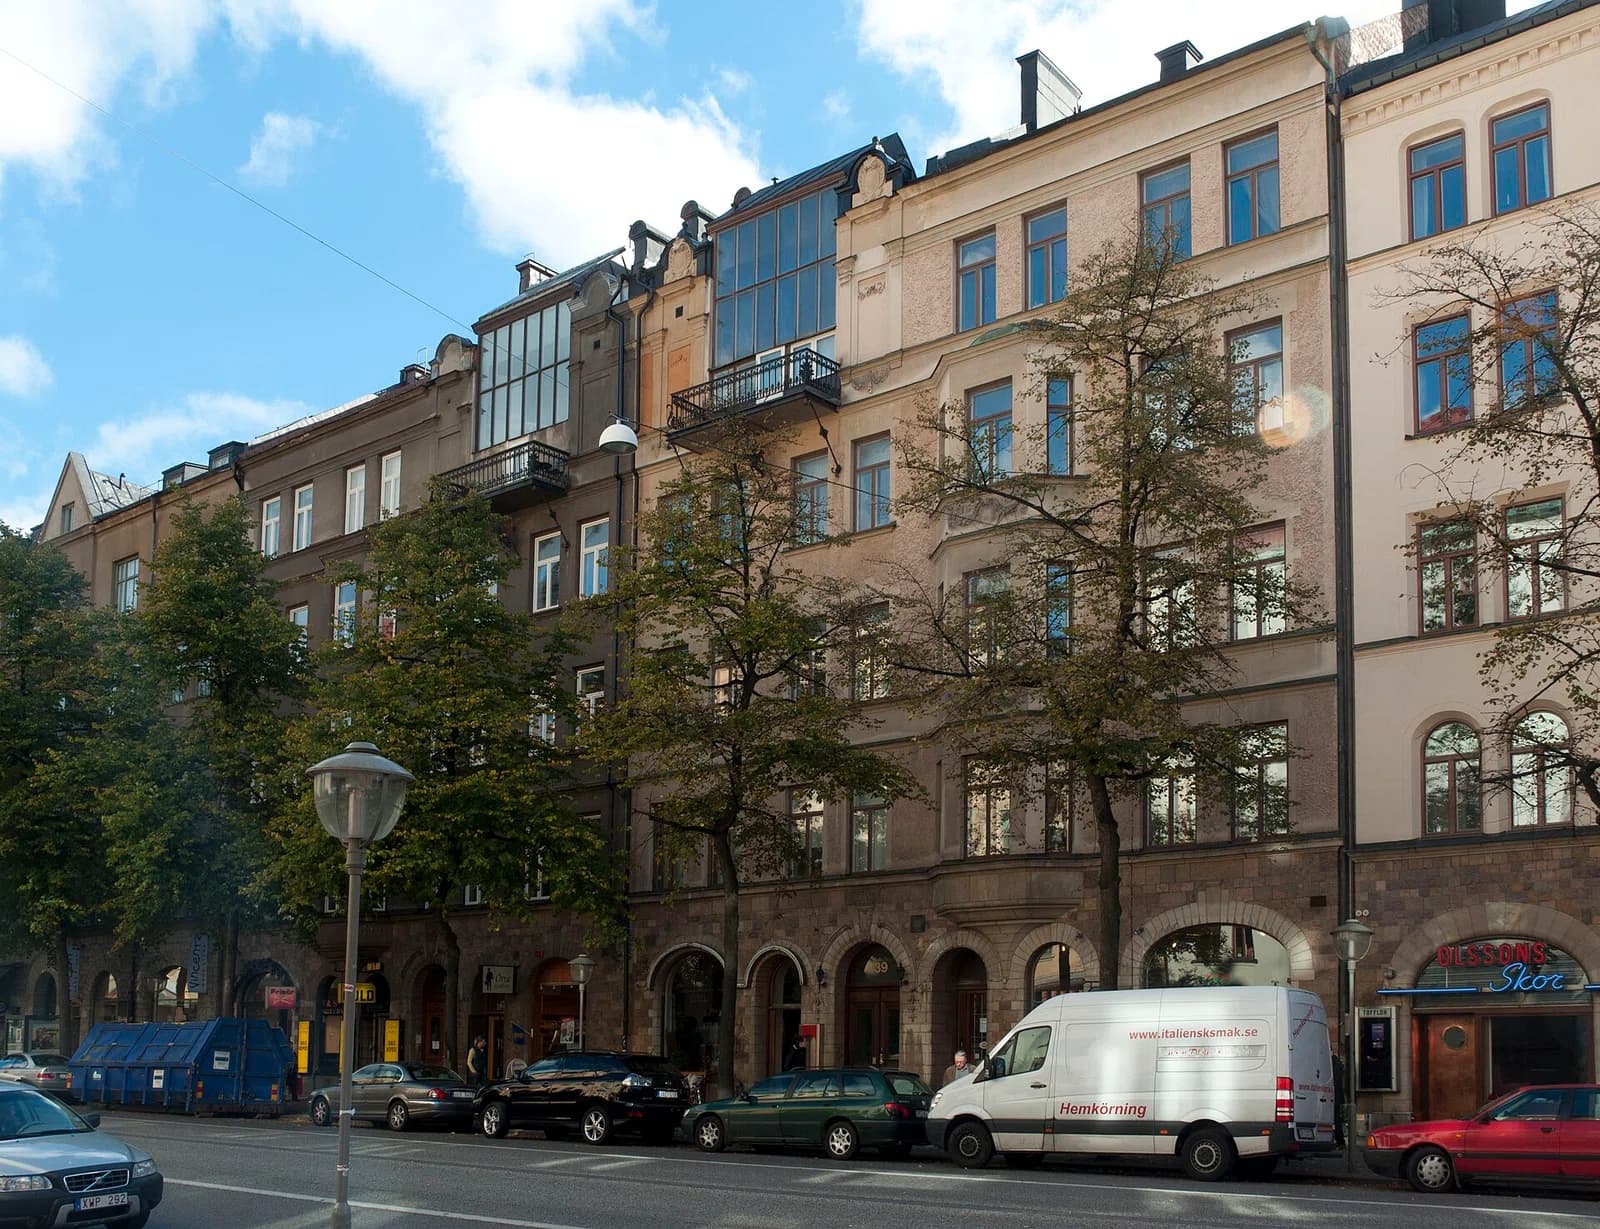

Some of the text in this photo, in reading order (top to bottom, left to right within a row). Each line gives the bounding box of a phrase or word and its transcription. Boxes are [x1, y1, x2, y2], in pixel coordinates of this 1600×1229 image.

[1437, 941, 1546, 967] OLSSONS
[1489, 962, 1564, 992] Skor
[1129, 1027, 1258, 1040] www.italiensksmak.se
[1060, 1102, 1147, 1118] Hemkörning
[82, 1193, 126, 1209] XWP 292
